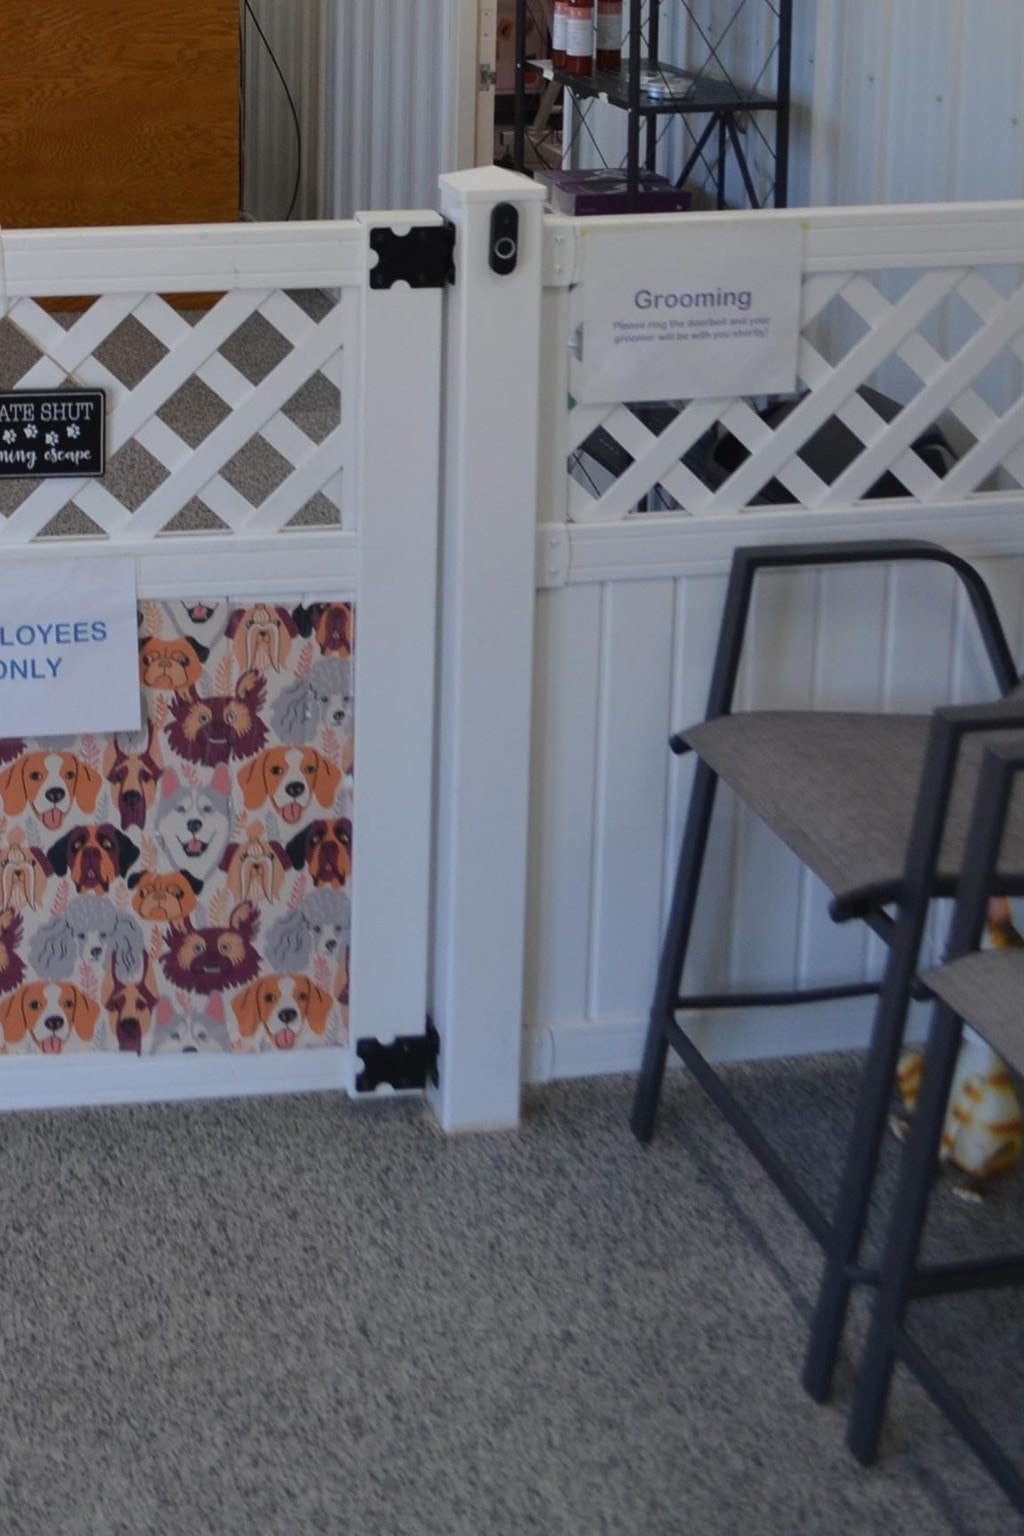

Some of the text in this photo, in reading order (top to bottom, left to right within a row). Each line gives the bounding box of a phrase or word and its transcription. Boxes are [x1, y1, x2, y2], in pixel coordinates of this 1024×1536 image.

[634, 287, 752, 310] Grooming
[669, 319, 684, 327] the
[730, 317, 747, 325] and
[676, 332, 688, 340] be
[40, 402, 94, 421] SHUT
[44, 446, 92, 465] escape
